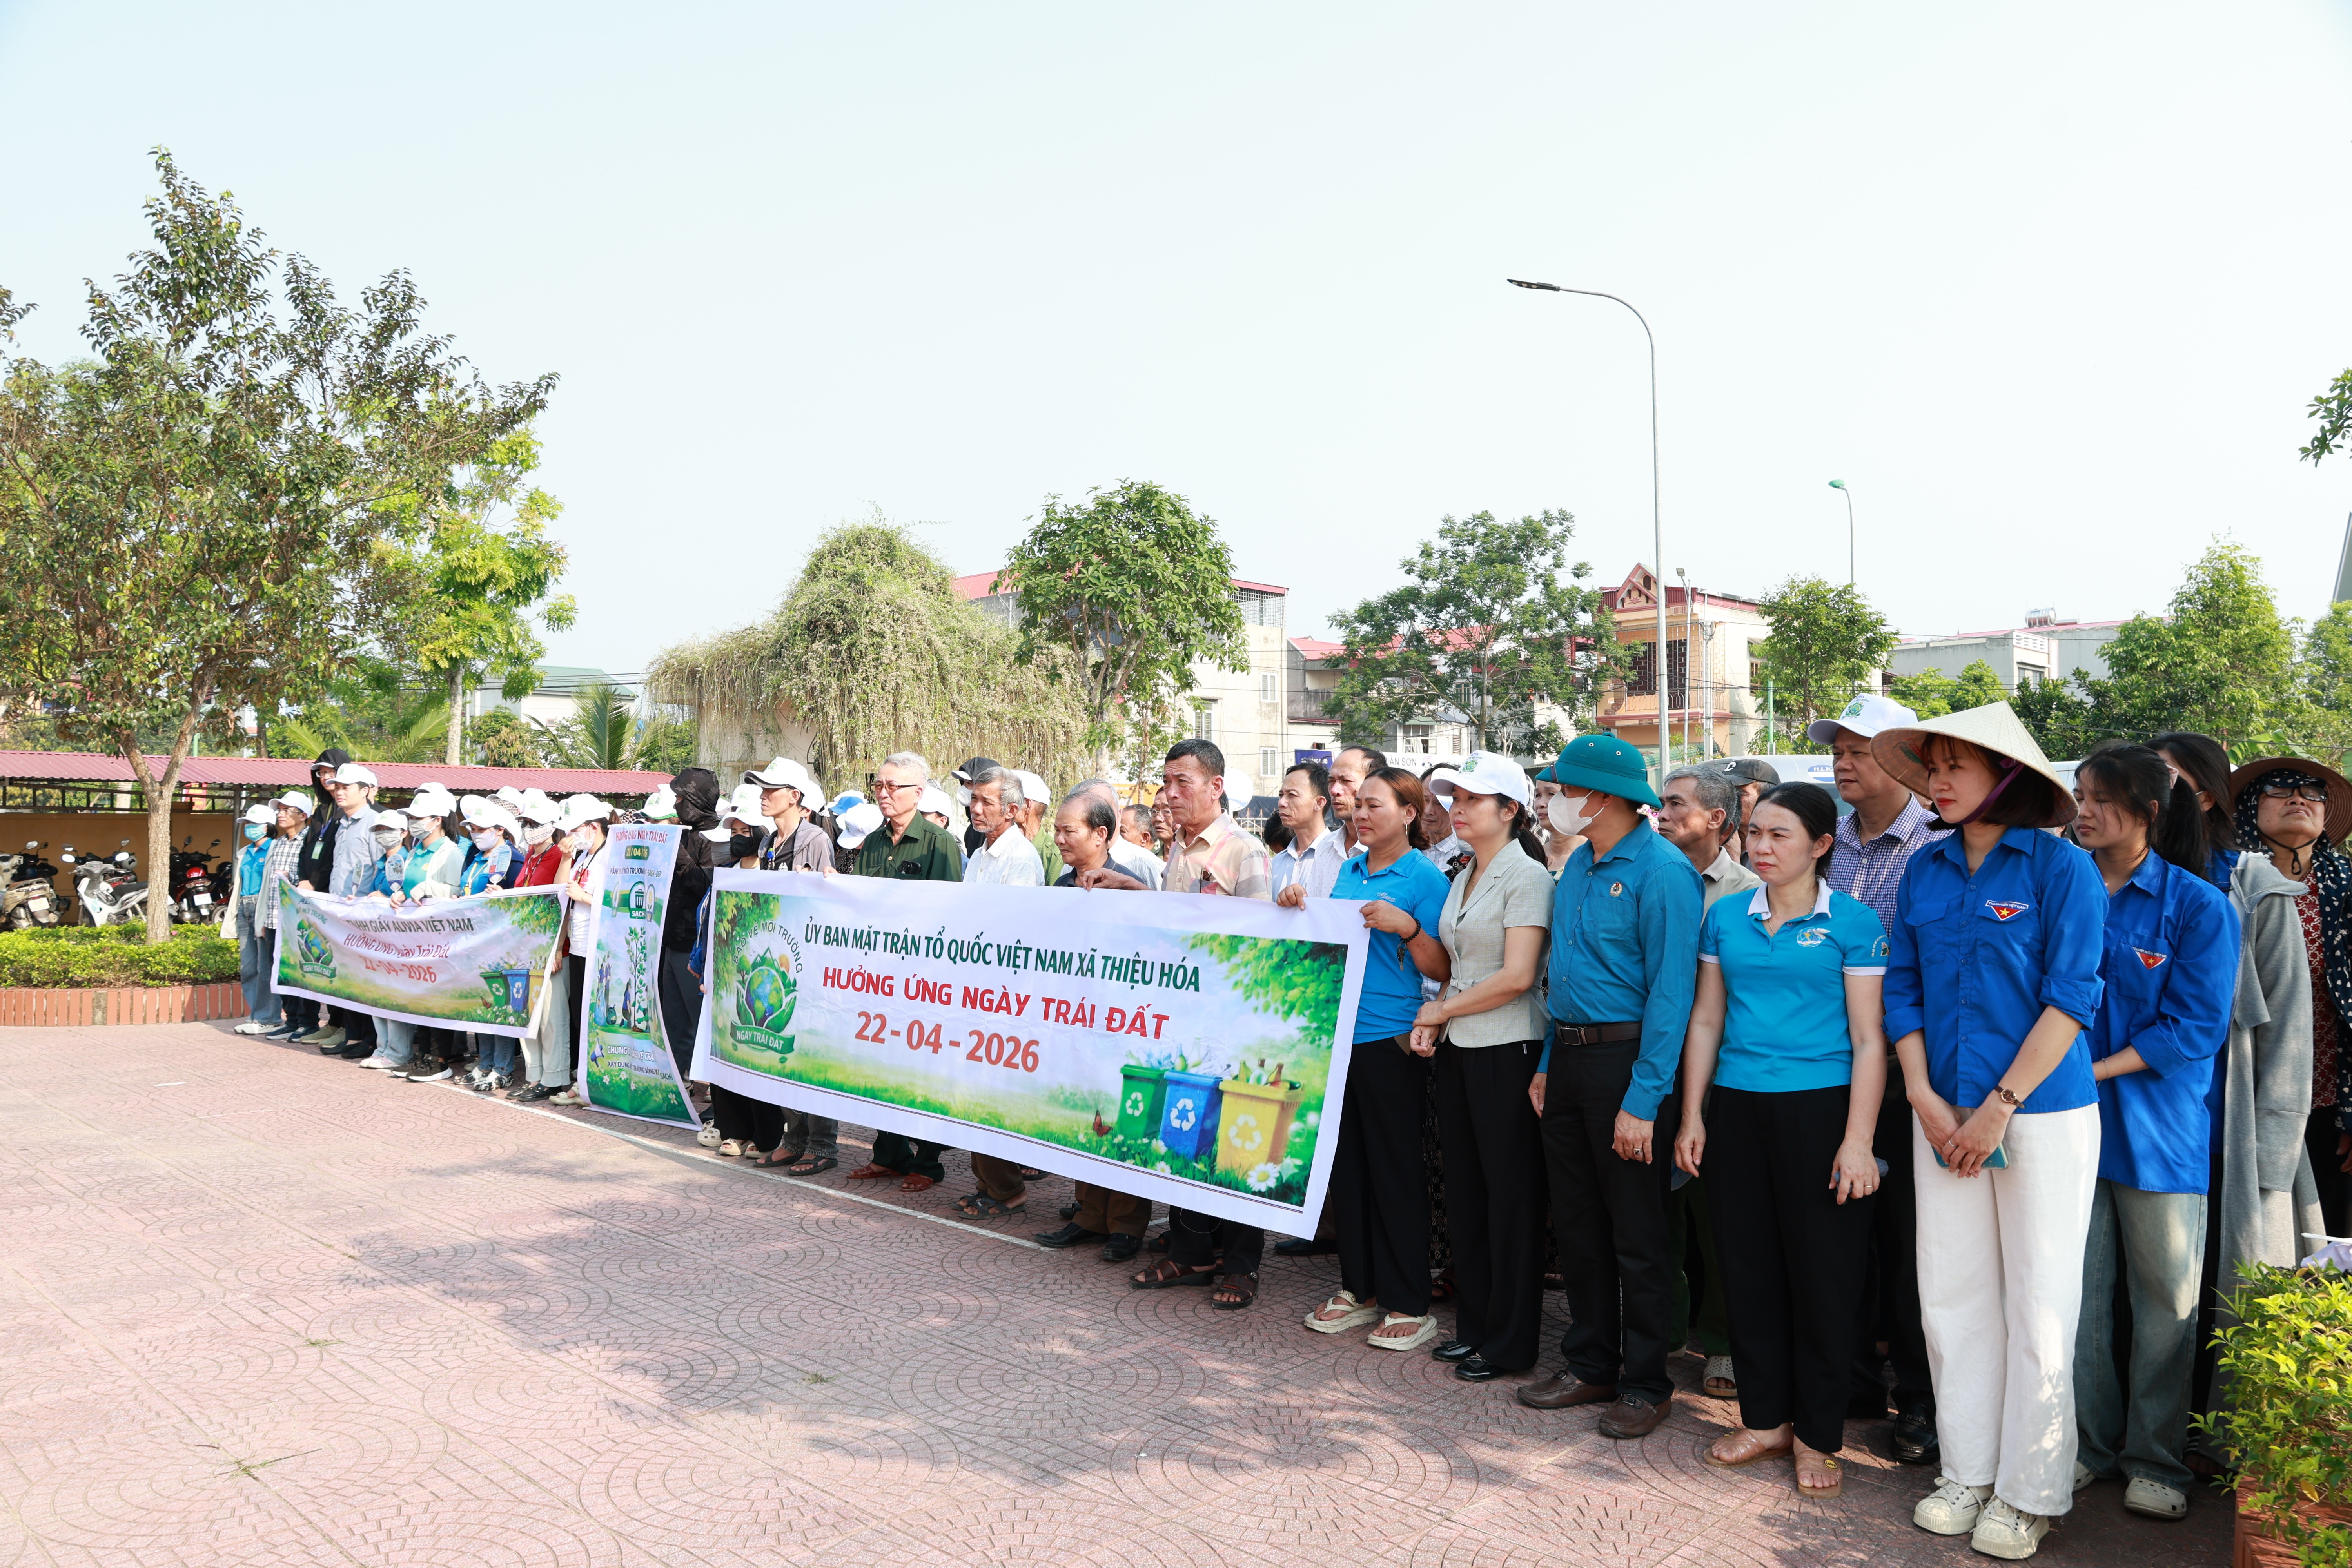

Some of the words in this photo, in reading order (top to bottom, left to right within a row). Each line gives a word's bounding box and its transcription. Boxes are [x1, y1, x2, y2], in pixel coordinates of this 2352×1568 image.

[1402, 758, 1416, 766] SƠN
[1724, 762, 1736, 771] C
[649, 829, 659, 842] TRÁI
[659, 829, 668, 844] ĐẤT
[370, 914, 391, 933] GIẤY
[392, 920, 424, 932] ALIVIA
[420, 916, 446, 935] VIỆT
[448, 918, 474, 932] NAM
[632, 911, 645, 919] SẠCH
[343, 933, 375, 950] HƯỞNG
[416, 944, 434, 958] Trái
[432, 942, 450, 958] Đất
[733, 936, 747, 964] BẢO
[748, 922, 759, 938] VỆ
[761, 919, 776, 933] MÔI
[778, 924, 803, 974] TRƯỜNG
[804, 916, 822, 944] ỦY
[823, 926, 850, 948] BAN
[851, 925, 880, 956] MẶT
[883, 928, 921, 960] TRẬN
[925, 926, 945, 959] TỔ
[947, 931, 993, 965] QUỐC
[996, 939, 1032, 975] VIỆT
[1034, 948, 1074, 976] NAM
[1074, 948, 1097, 978] XÃ
[1100, 951, 1154, 990] THIỆU
[1158, 956, 1200, 992] HÓA
[823, 965, 894, 997] HƯỞNG
[904, 973, 952, 1005] ỨNG
[962, 985, 1031, 1017] NGÀY
[1041, 996, 1096, 1029] TRÁI
[1105, 1003, 1170, 1040] ĐẤT
[736, 1027, 753, 1041] NGÀY
[753, 1031, 768, 1045] TRÁI
[769, 1034, 784, 1051] ĐẤT
[607, 1045, 627, 1055] CHUNG
